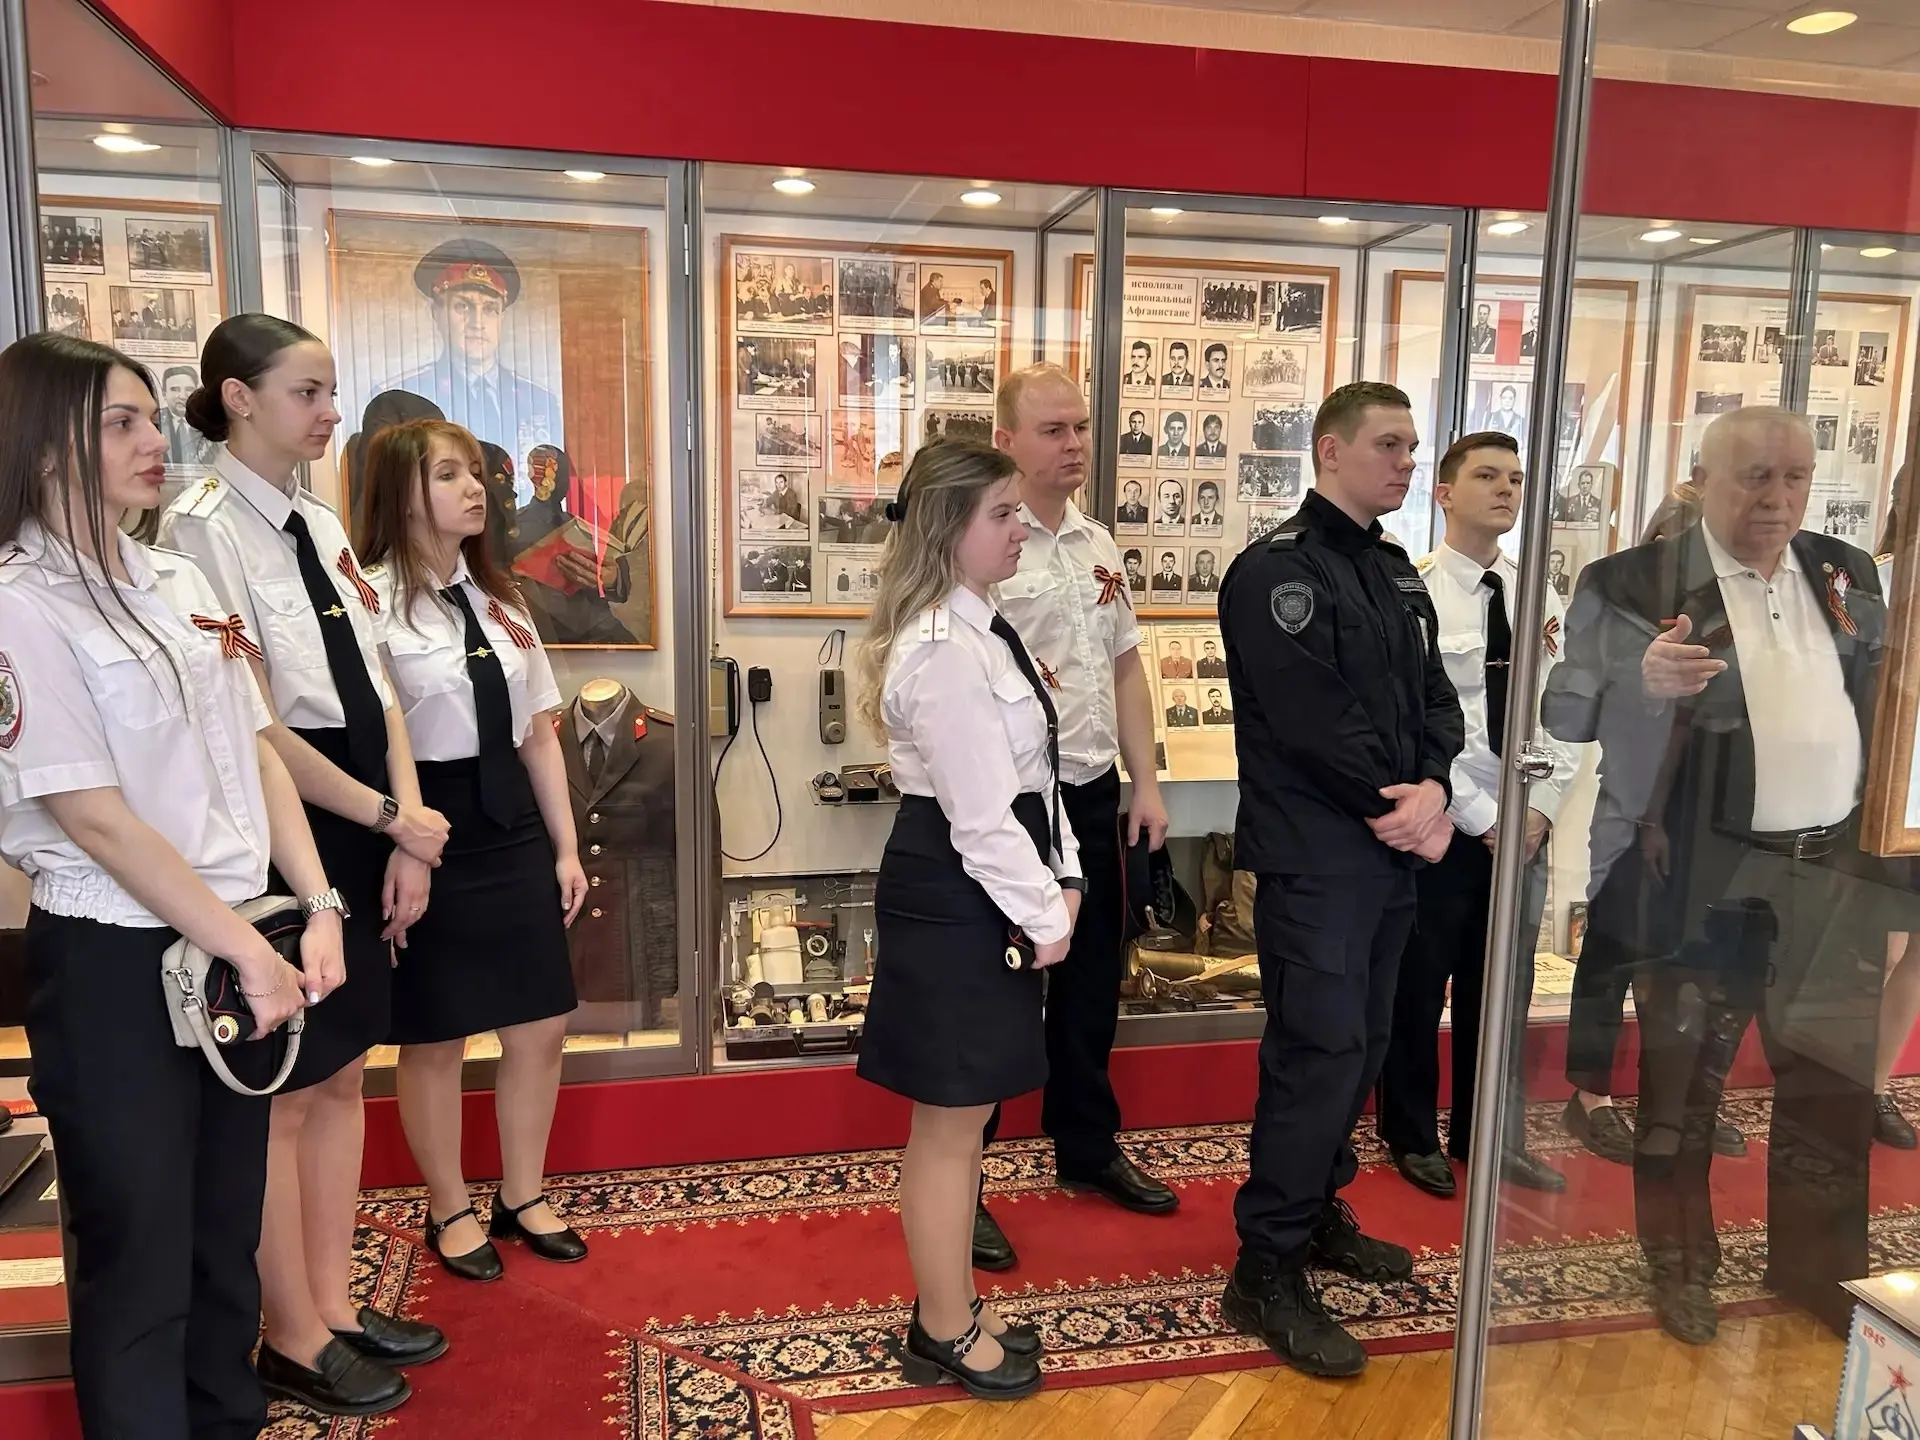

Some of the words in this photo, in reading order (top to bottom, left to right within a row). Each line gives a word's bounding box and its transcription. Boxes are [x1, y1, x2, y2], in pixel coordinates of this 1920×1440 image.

[1131, 280, 1184, 291] исполняли
[1126, 305, 1190, 318] Афганистане
[1862, 1324, 1886, 1349] 1945
